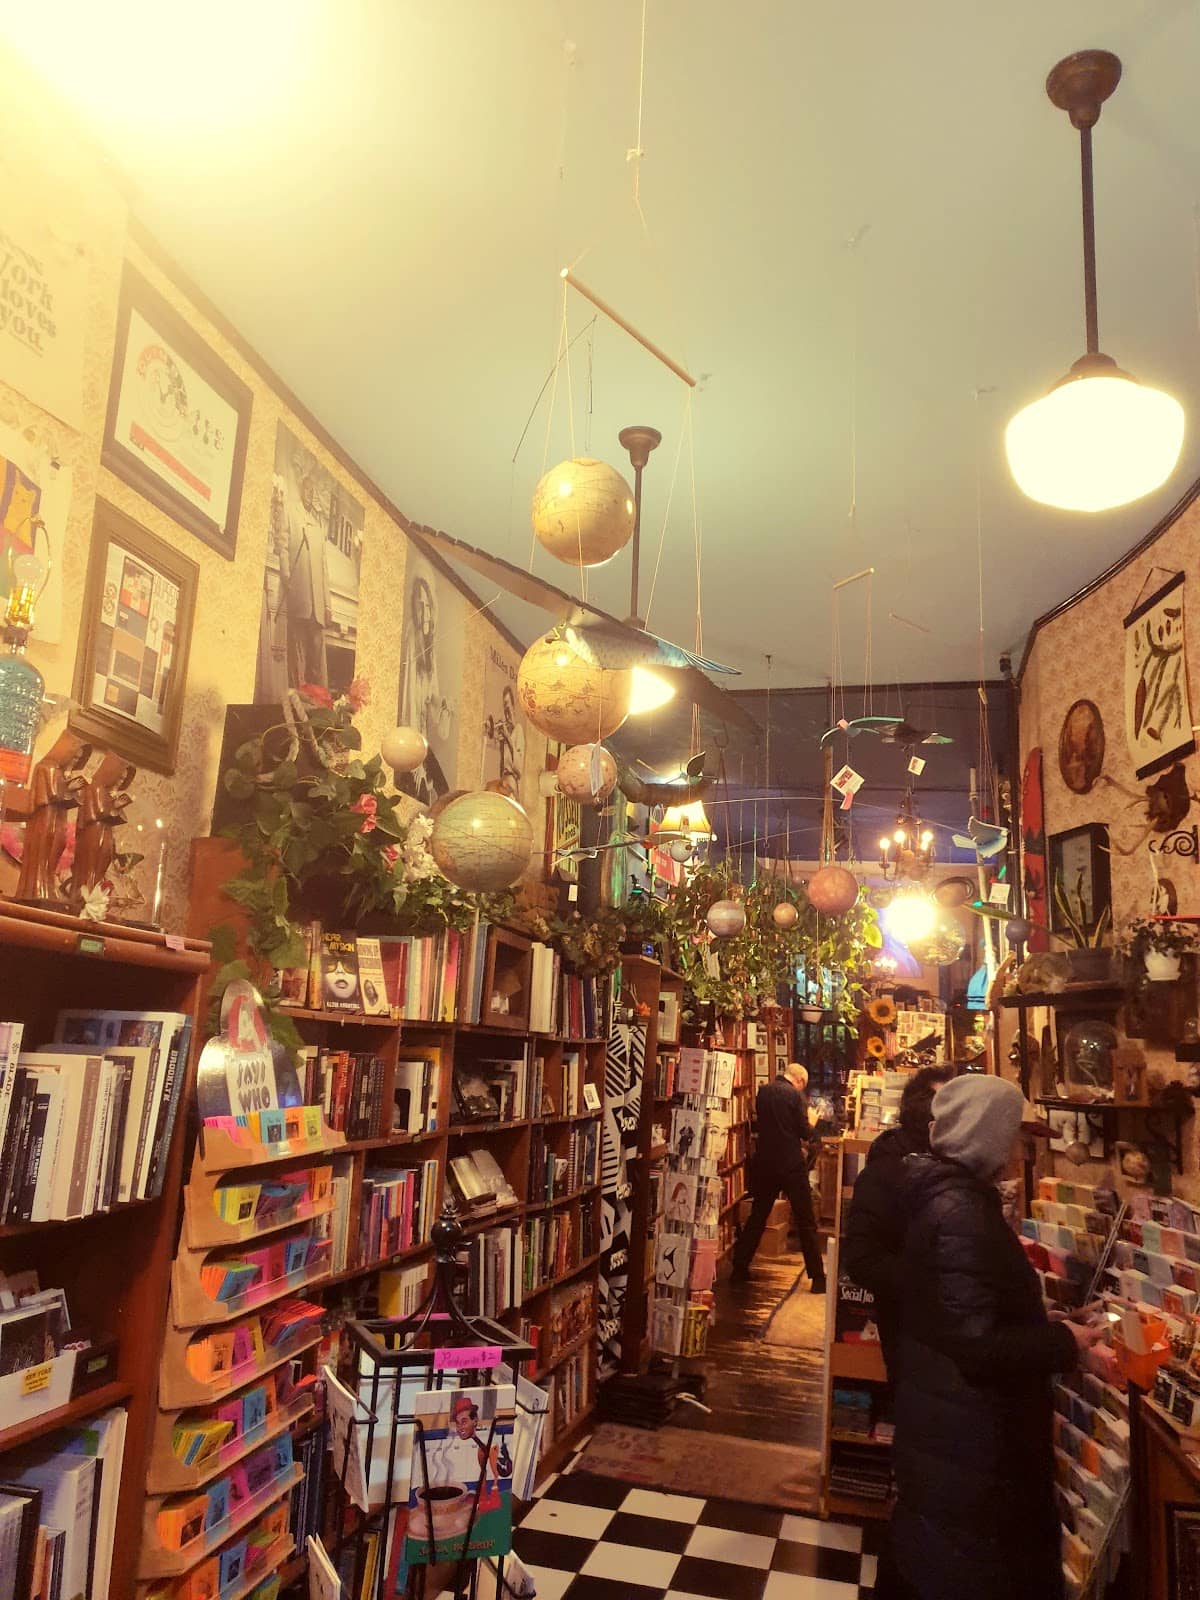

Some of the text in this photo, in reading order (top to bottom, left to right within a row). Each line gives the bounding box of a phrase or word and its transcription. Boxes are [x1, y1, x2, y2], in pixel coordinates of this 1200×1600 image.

[1, 278, 57, 338] loves
[163, 1050, 178, 1102] BROOKLYN
[238, 1086, 271, 1113] WHO
